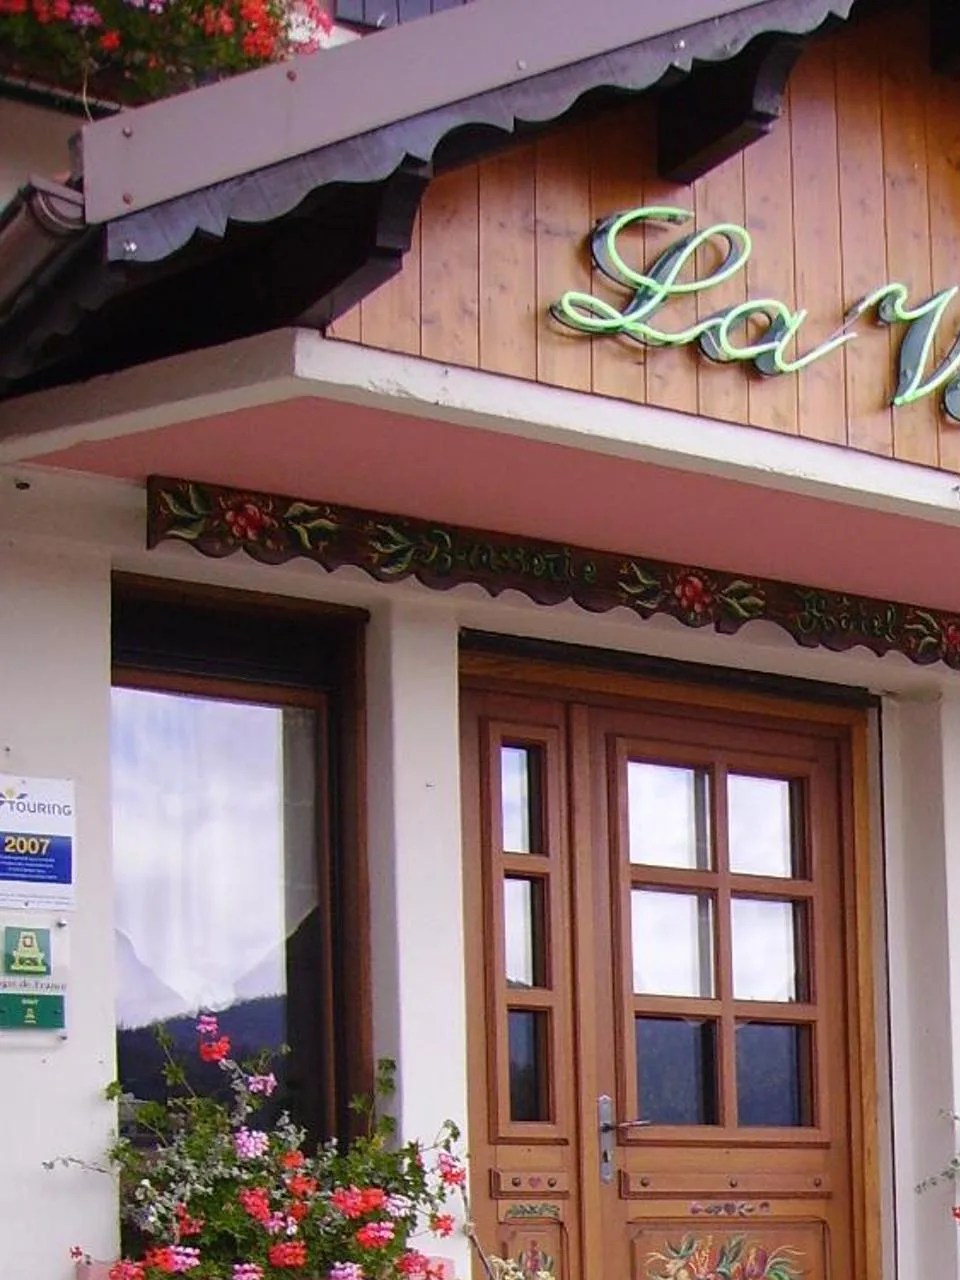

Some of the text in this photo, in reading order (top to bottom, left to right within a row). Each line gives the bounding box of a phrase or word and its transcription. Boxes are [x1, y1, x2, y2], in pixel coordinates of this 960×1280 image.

[550, 206, 857, 376] La
[9, 801, 73, 816] TOURING
[4, 836, 50, 856] 2007
